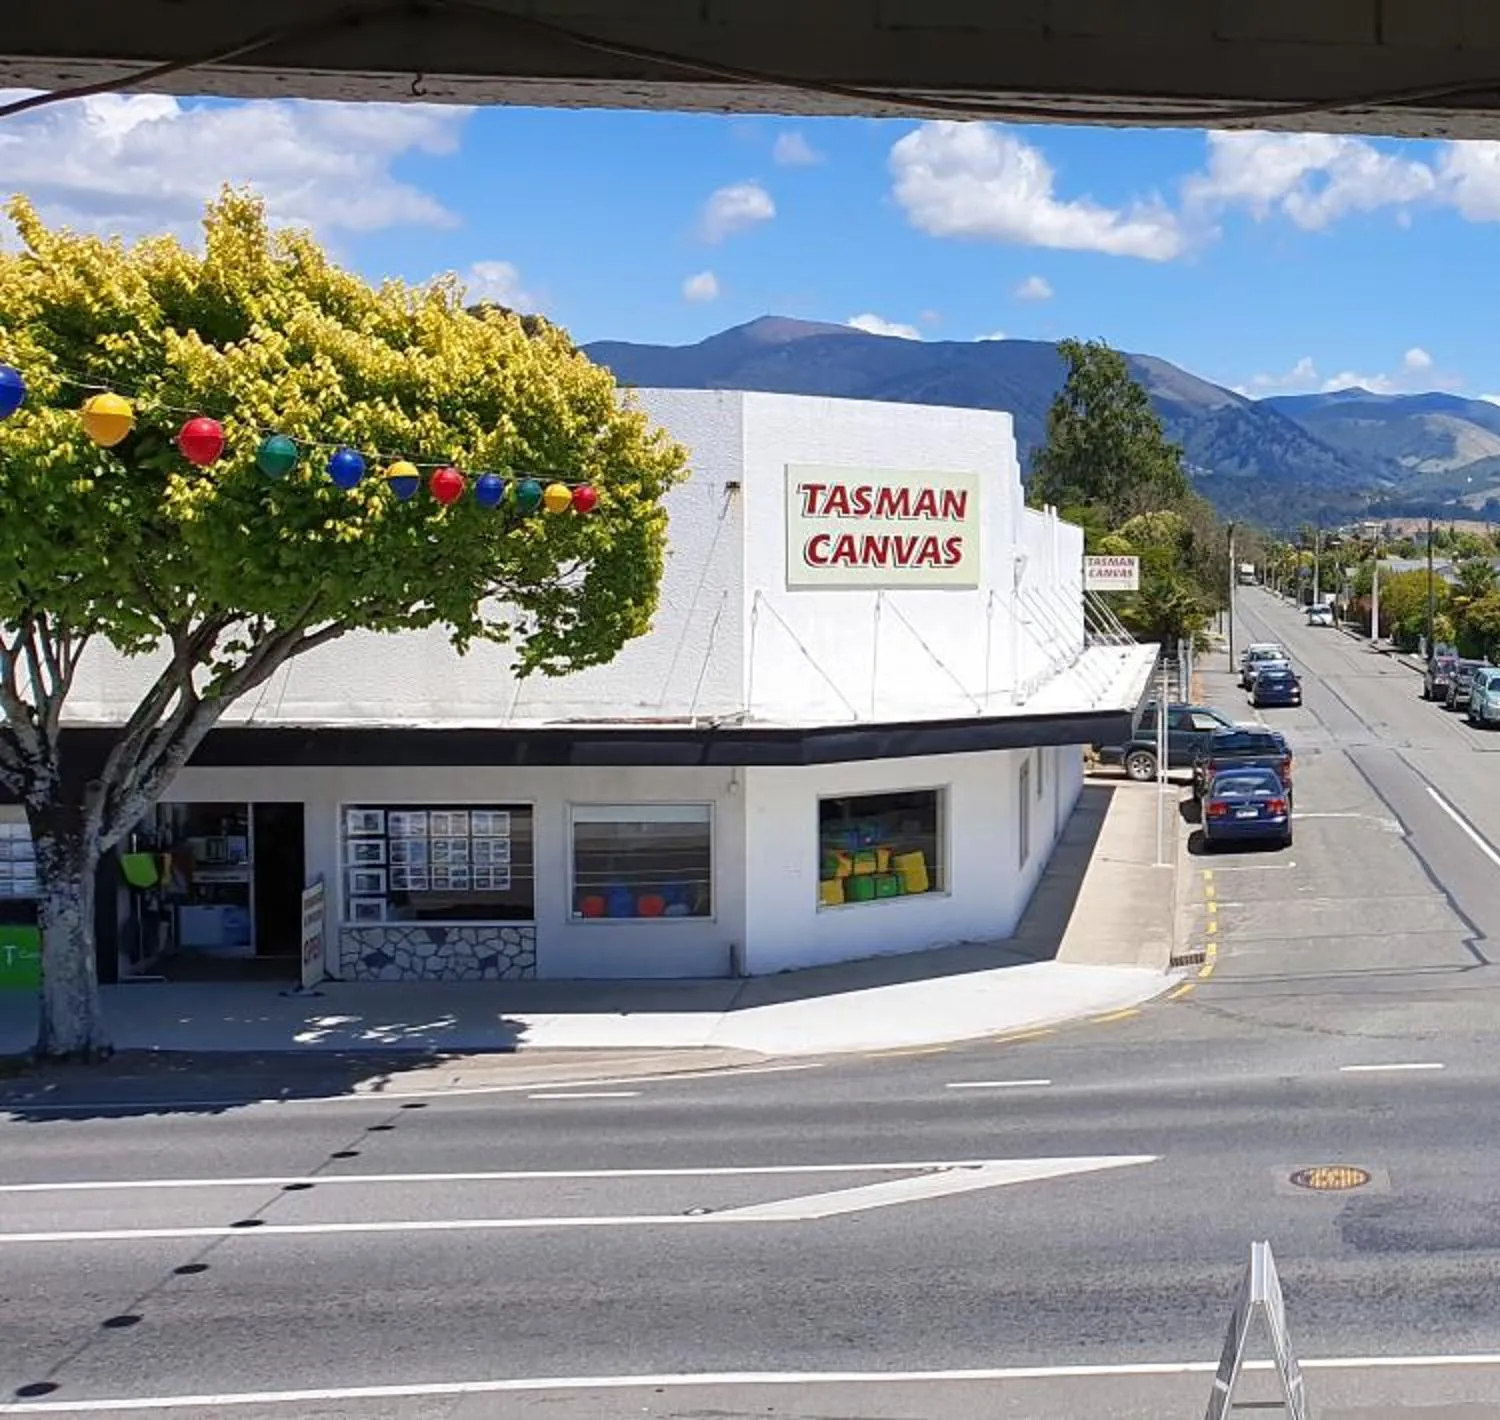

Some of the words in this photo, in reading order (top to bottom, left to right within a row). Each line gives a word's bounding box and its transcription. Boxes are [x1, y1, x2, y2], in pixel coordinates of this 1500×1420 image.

[796, 482, 968, 521] TASMAN
[803, 533, 963, 568] CANVAS
[1088, 557, 1135, 567] TASMAN
[1088, 568, 1134, 578] CANVAS
